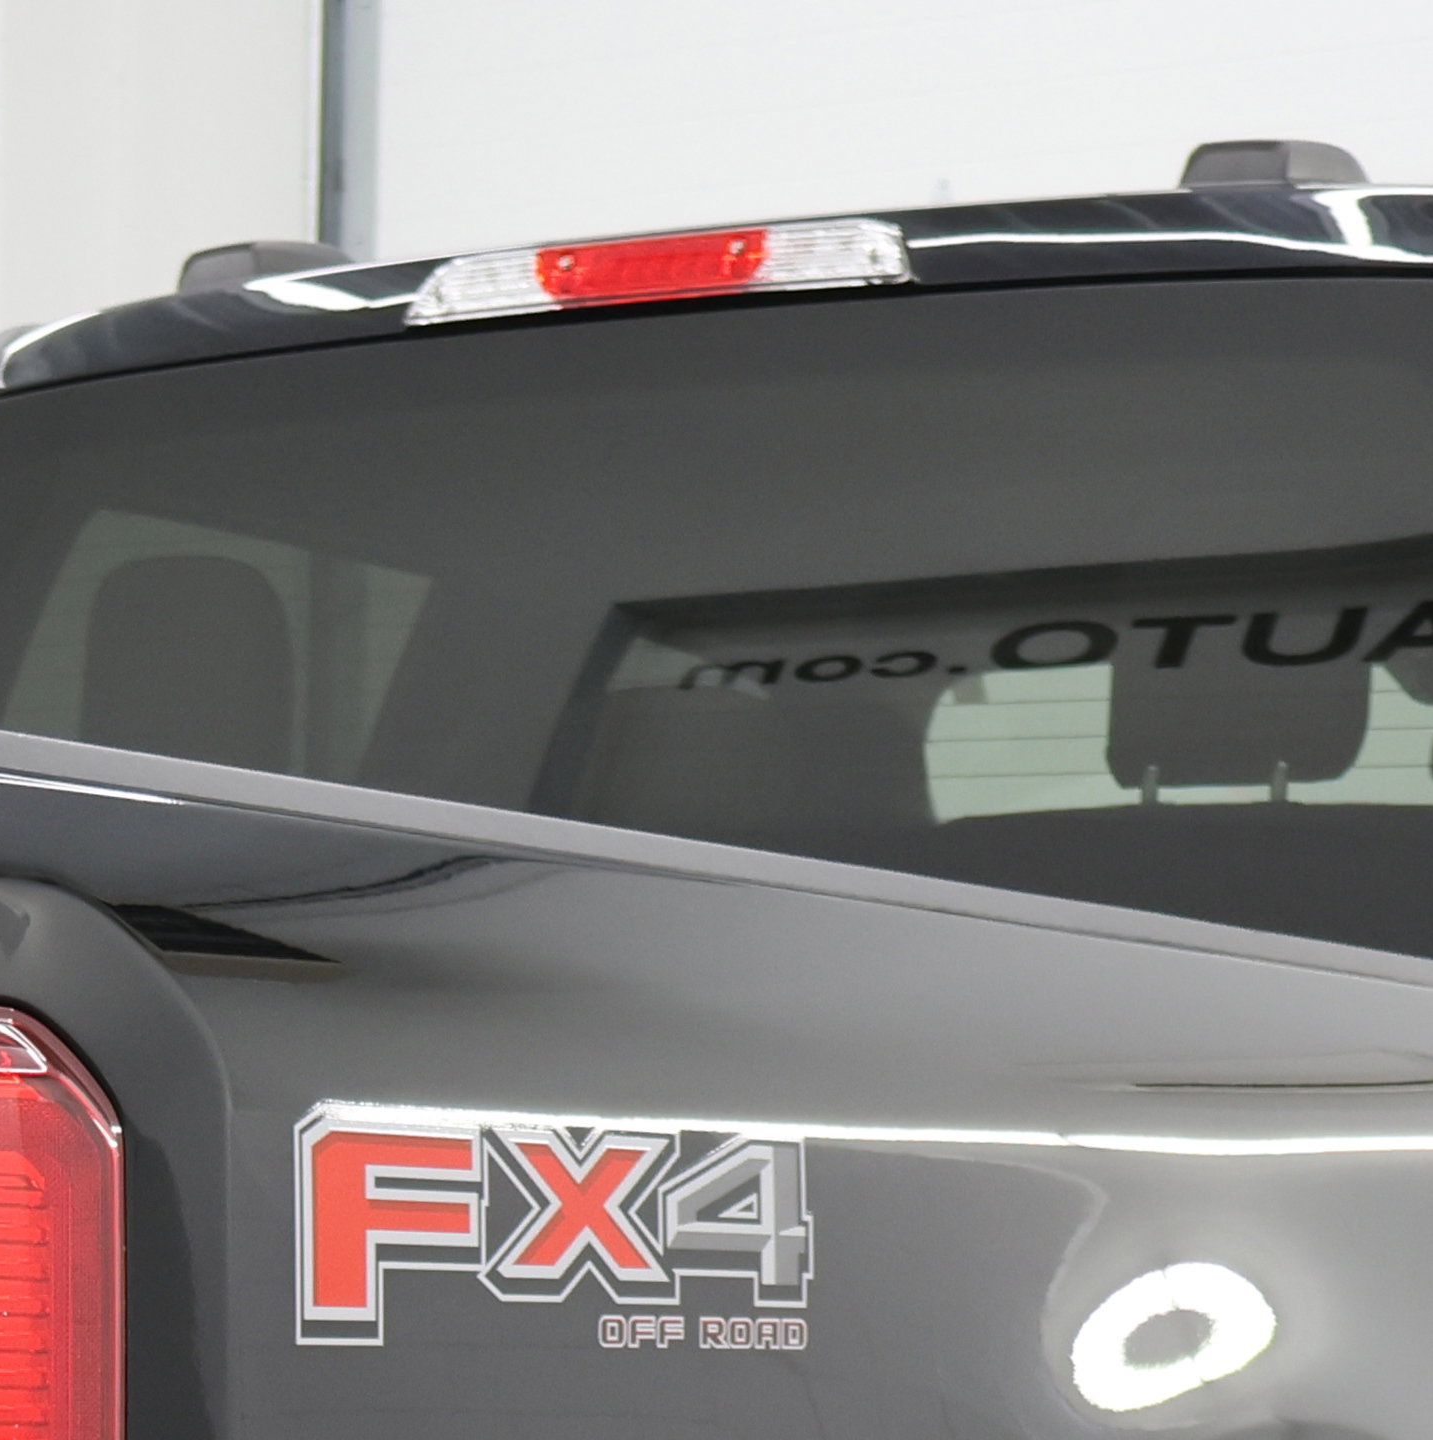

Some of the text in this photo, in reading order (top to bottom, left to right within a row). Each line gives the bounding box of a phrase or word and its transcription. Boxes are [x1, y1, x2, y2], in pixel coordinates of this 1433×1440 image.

[294, 1099, 813, 1346] FX4
[598, 1314, 808, 1350] OFF ROAD
